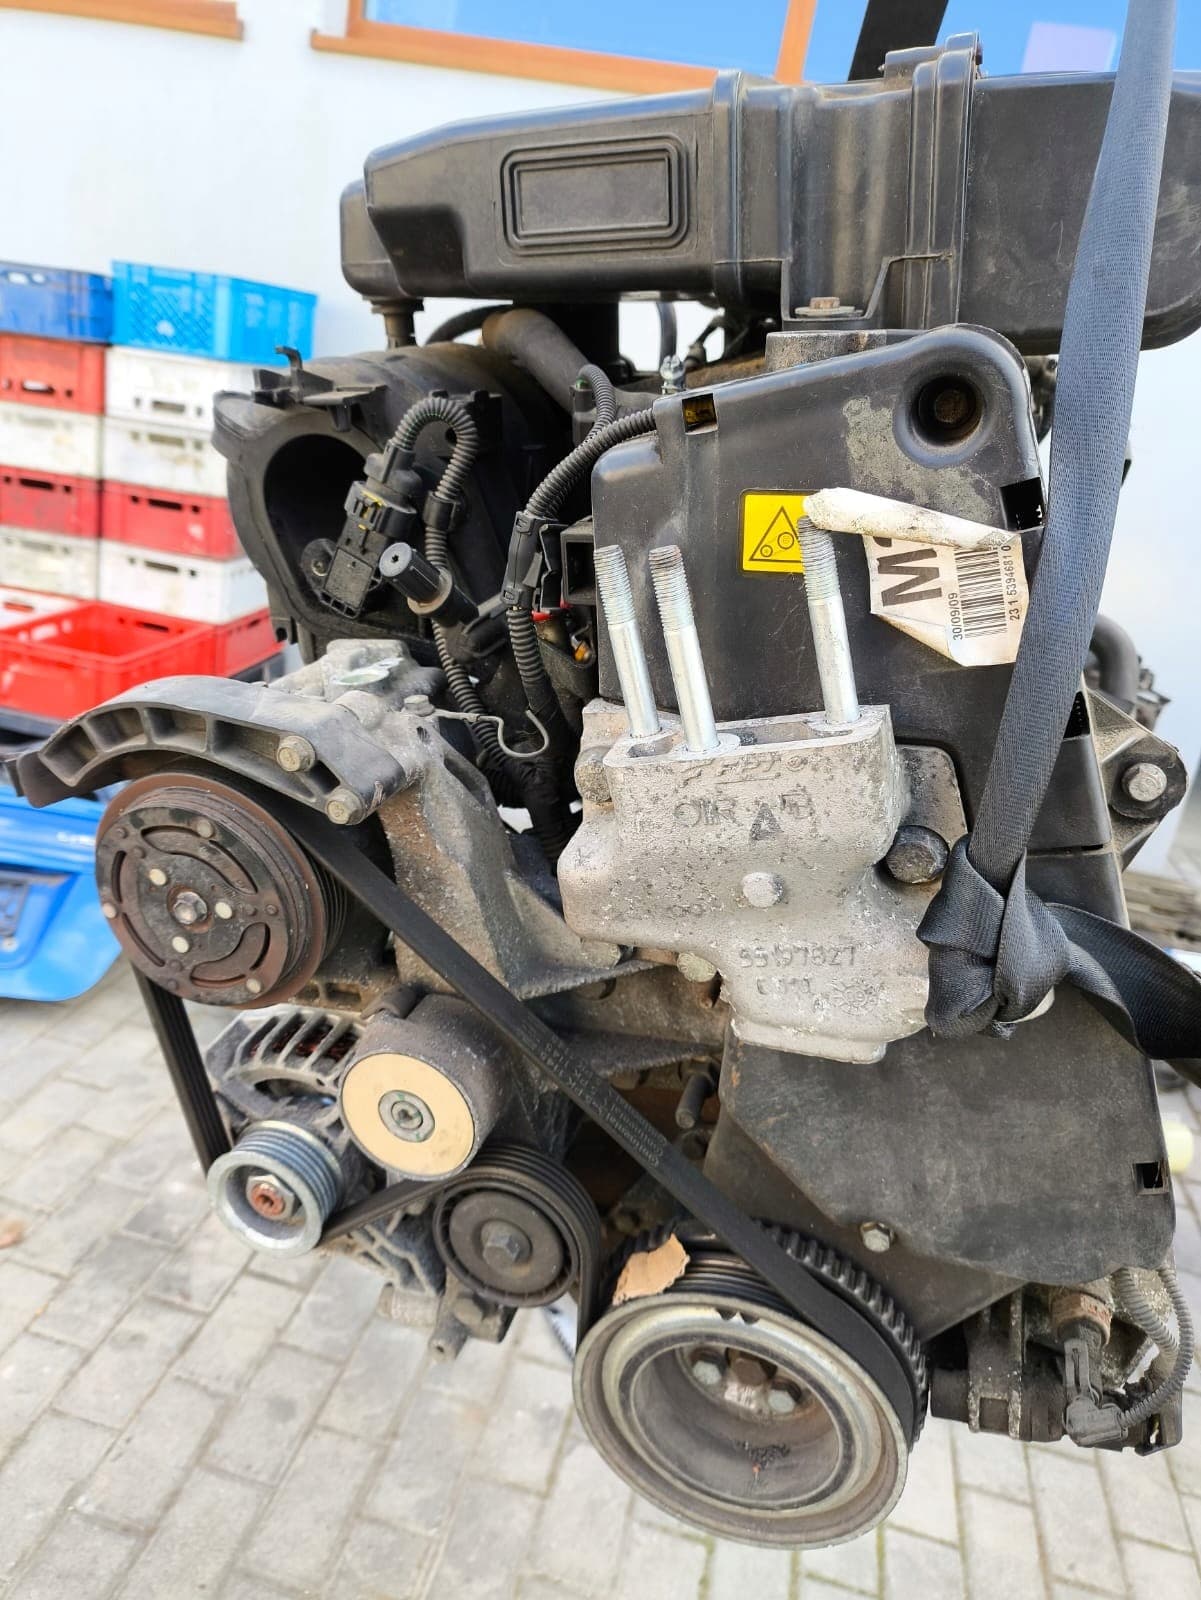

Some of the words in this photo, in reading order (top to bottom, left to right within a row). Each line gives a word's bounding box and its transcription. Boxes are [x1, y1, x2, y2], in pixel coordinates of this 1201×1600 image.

[873, 536, 942, 607] M
[1003, 554, 1018, 596] 5394681
[948, 592, 963, 641] 30/09/09
[1008, 608, 1020, 621] 23
